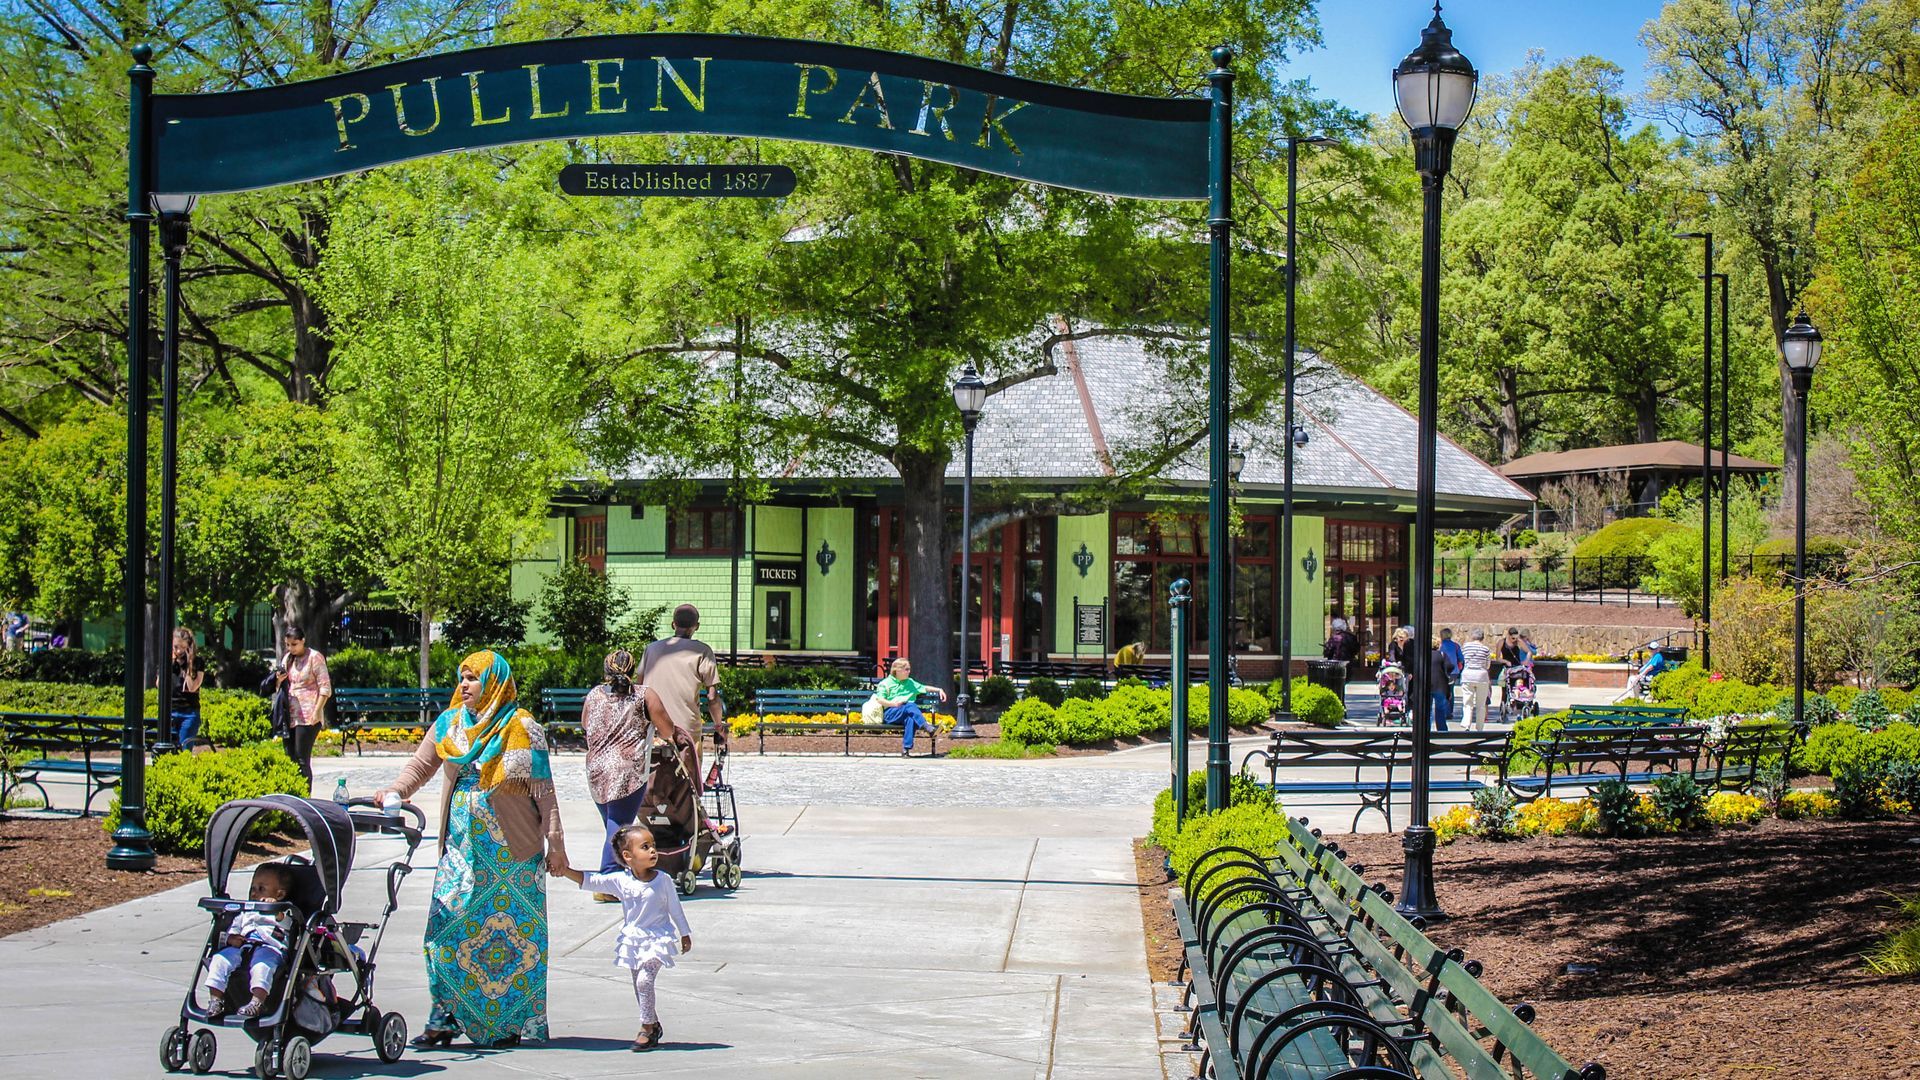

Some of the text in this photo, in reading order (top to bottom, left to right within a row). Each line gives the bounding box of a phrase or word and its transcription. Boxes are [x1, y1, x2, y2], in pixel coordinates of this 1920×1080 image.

[325, 56, 1031, 156] PULLEN PARK
[585, 171, 711, 190] Established
[1078, 555, 1091, 565] PP
[760, 568, 797, 580] TICKETS
